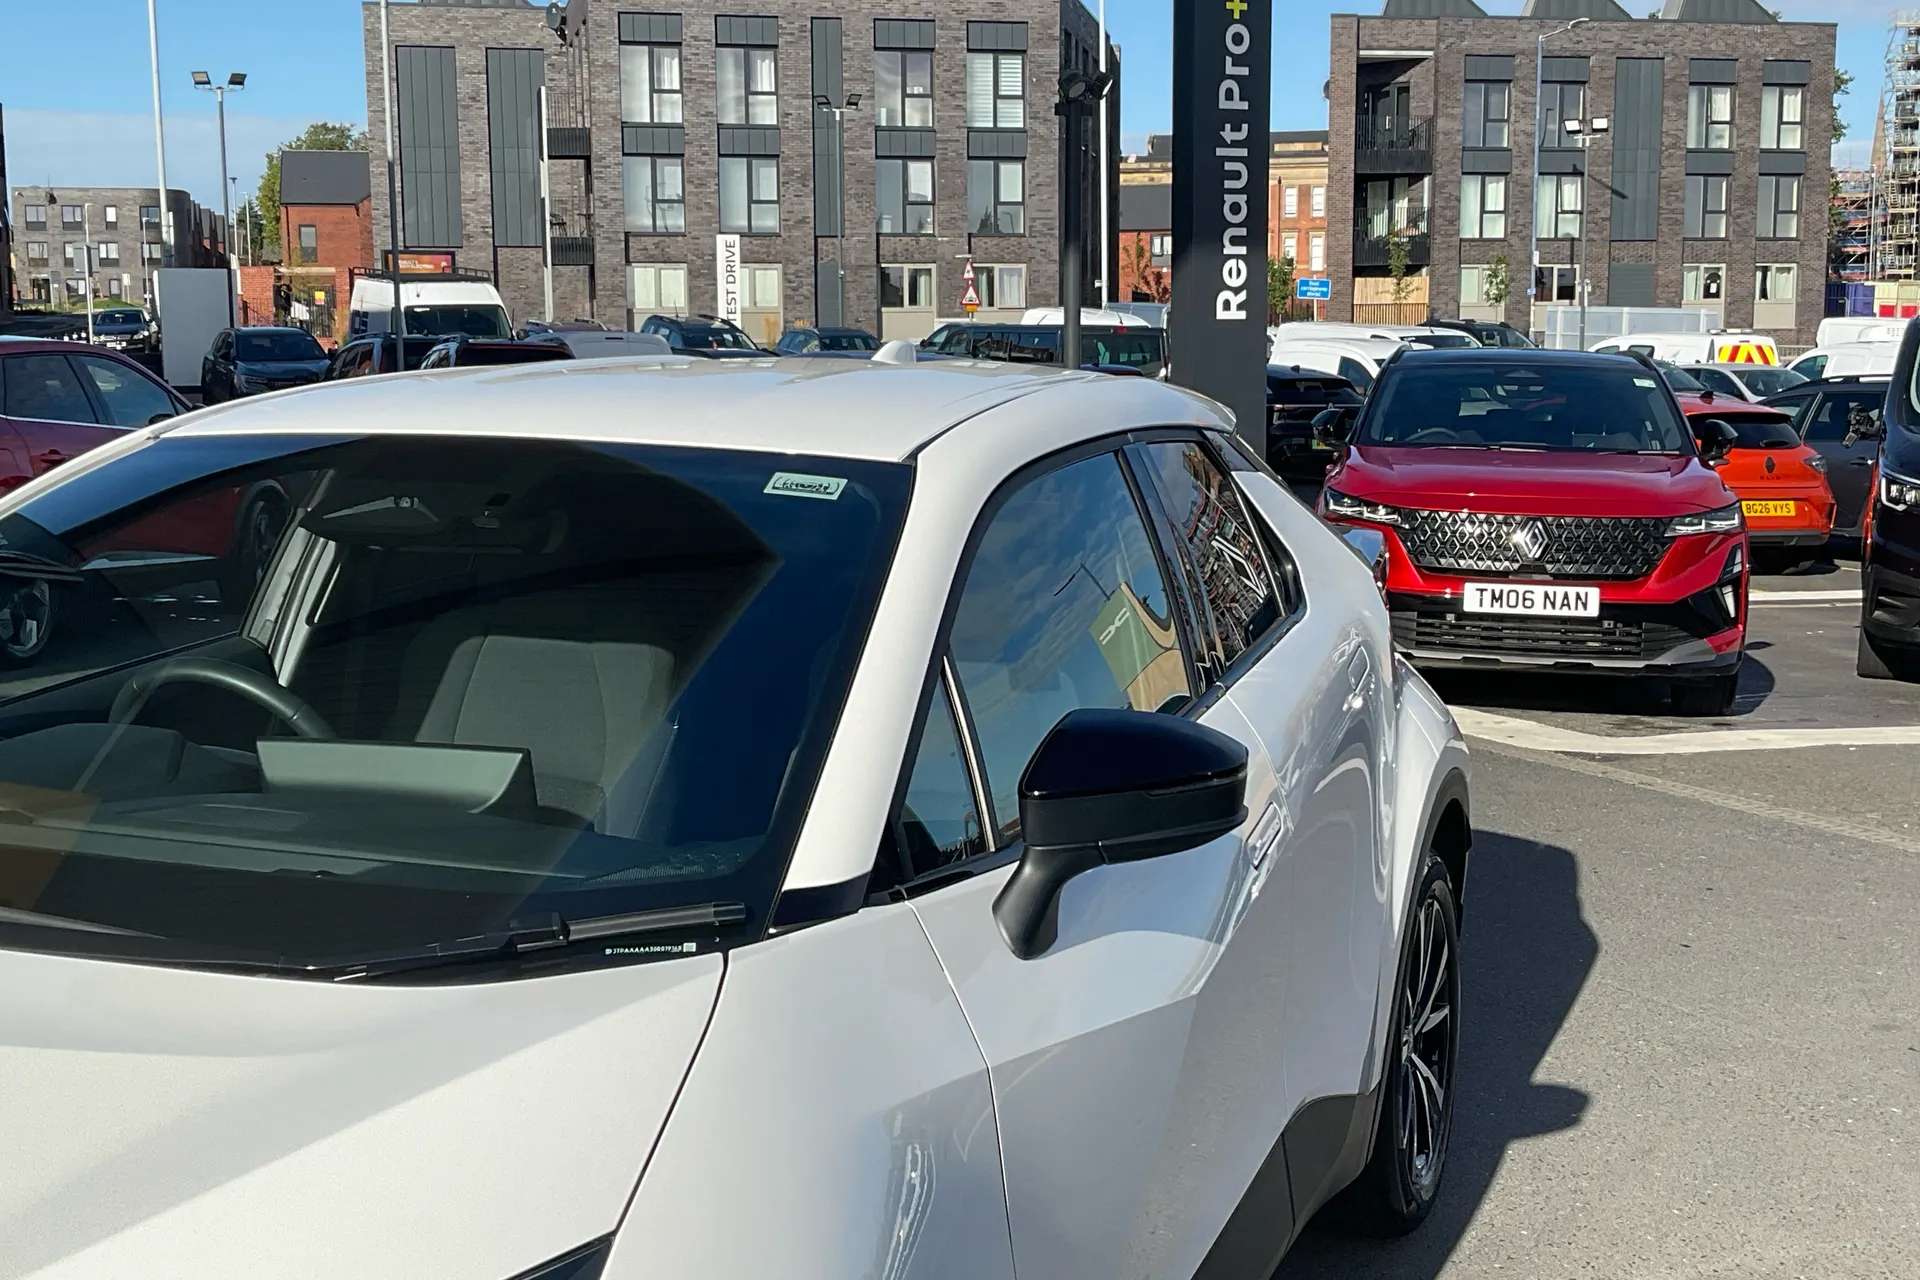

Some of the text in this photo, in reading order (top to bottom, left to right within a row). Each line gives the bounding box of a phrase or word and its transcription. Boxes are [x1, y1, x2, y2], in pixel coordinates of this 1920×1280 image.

[1216, 123, 1249, 320] Renault
[725, 240, 736, 285] DRIVE
[1745, 503, 1792, 514] BG26 VYS
[1476, 588, 1588, 611] TM06 NAN
